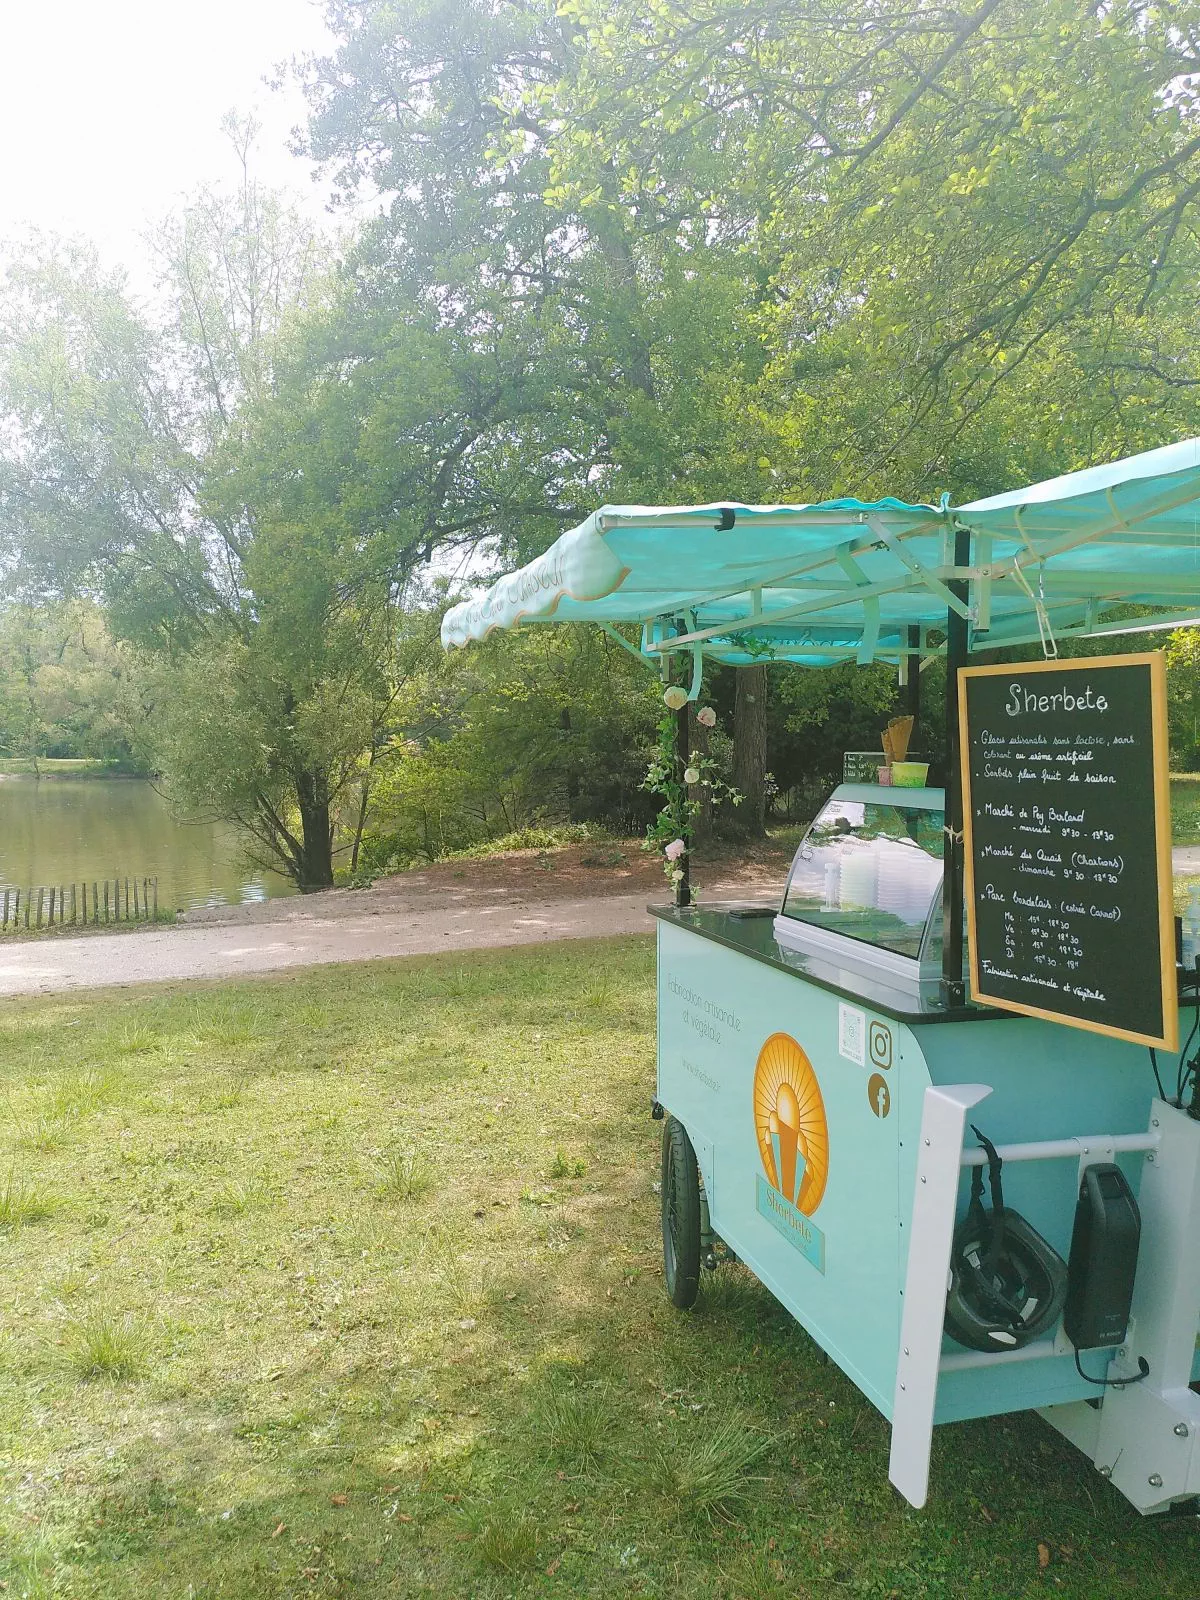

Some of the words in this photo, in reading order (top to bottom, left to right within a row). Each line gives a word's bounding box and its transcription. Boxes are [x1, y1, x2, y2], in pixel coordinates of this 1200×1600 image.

[1052, 736, 1070, 745] sans
[1112, 734, 1135, 745] sans
[1055, 750, 1094, 765] artificiel
[984, 763, 1013, 778] Sorbets
[1017, 768, 1037, 784] plein
[1040, 768, 1062, 784] fruit
[1067, 771, 1080, 782] de
[1084, 772, 1117, 784] saison
[985, 802, 1015, 818] Marché
[1019, 807, 1028, 818] de
[1032, 805, 1044, 826] Pey
[1048, 807, 1085, 822] Berland
[1019, 825, 1051, 834] mercredi
[984, 844, 1014, 858] Marché
[1020, 849, 1032, 860] des
[1036, 848, 1062, 863] Quais
[1018, 863, 1056, 877] dimanche
[985, 883, 1005, 902] Parc
[1004, 911, 1015, 921] Me
[1004, 923, 1015, 934] Ve
[1005, 934, 1016, 946] Sa
[981, 959, 1019, 980] Fabrication
[1020, 973, 1059, 989] artisanale
[1062, 982, 1071, 992] et
